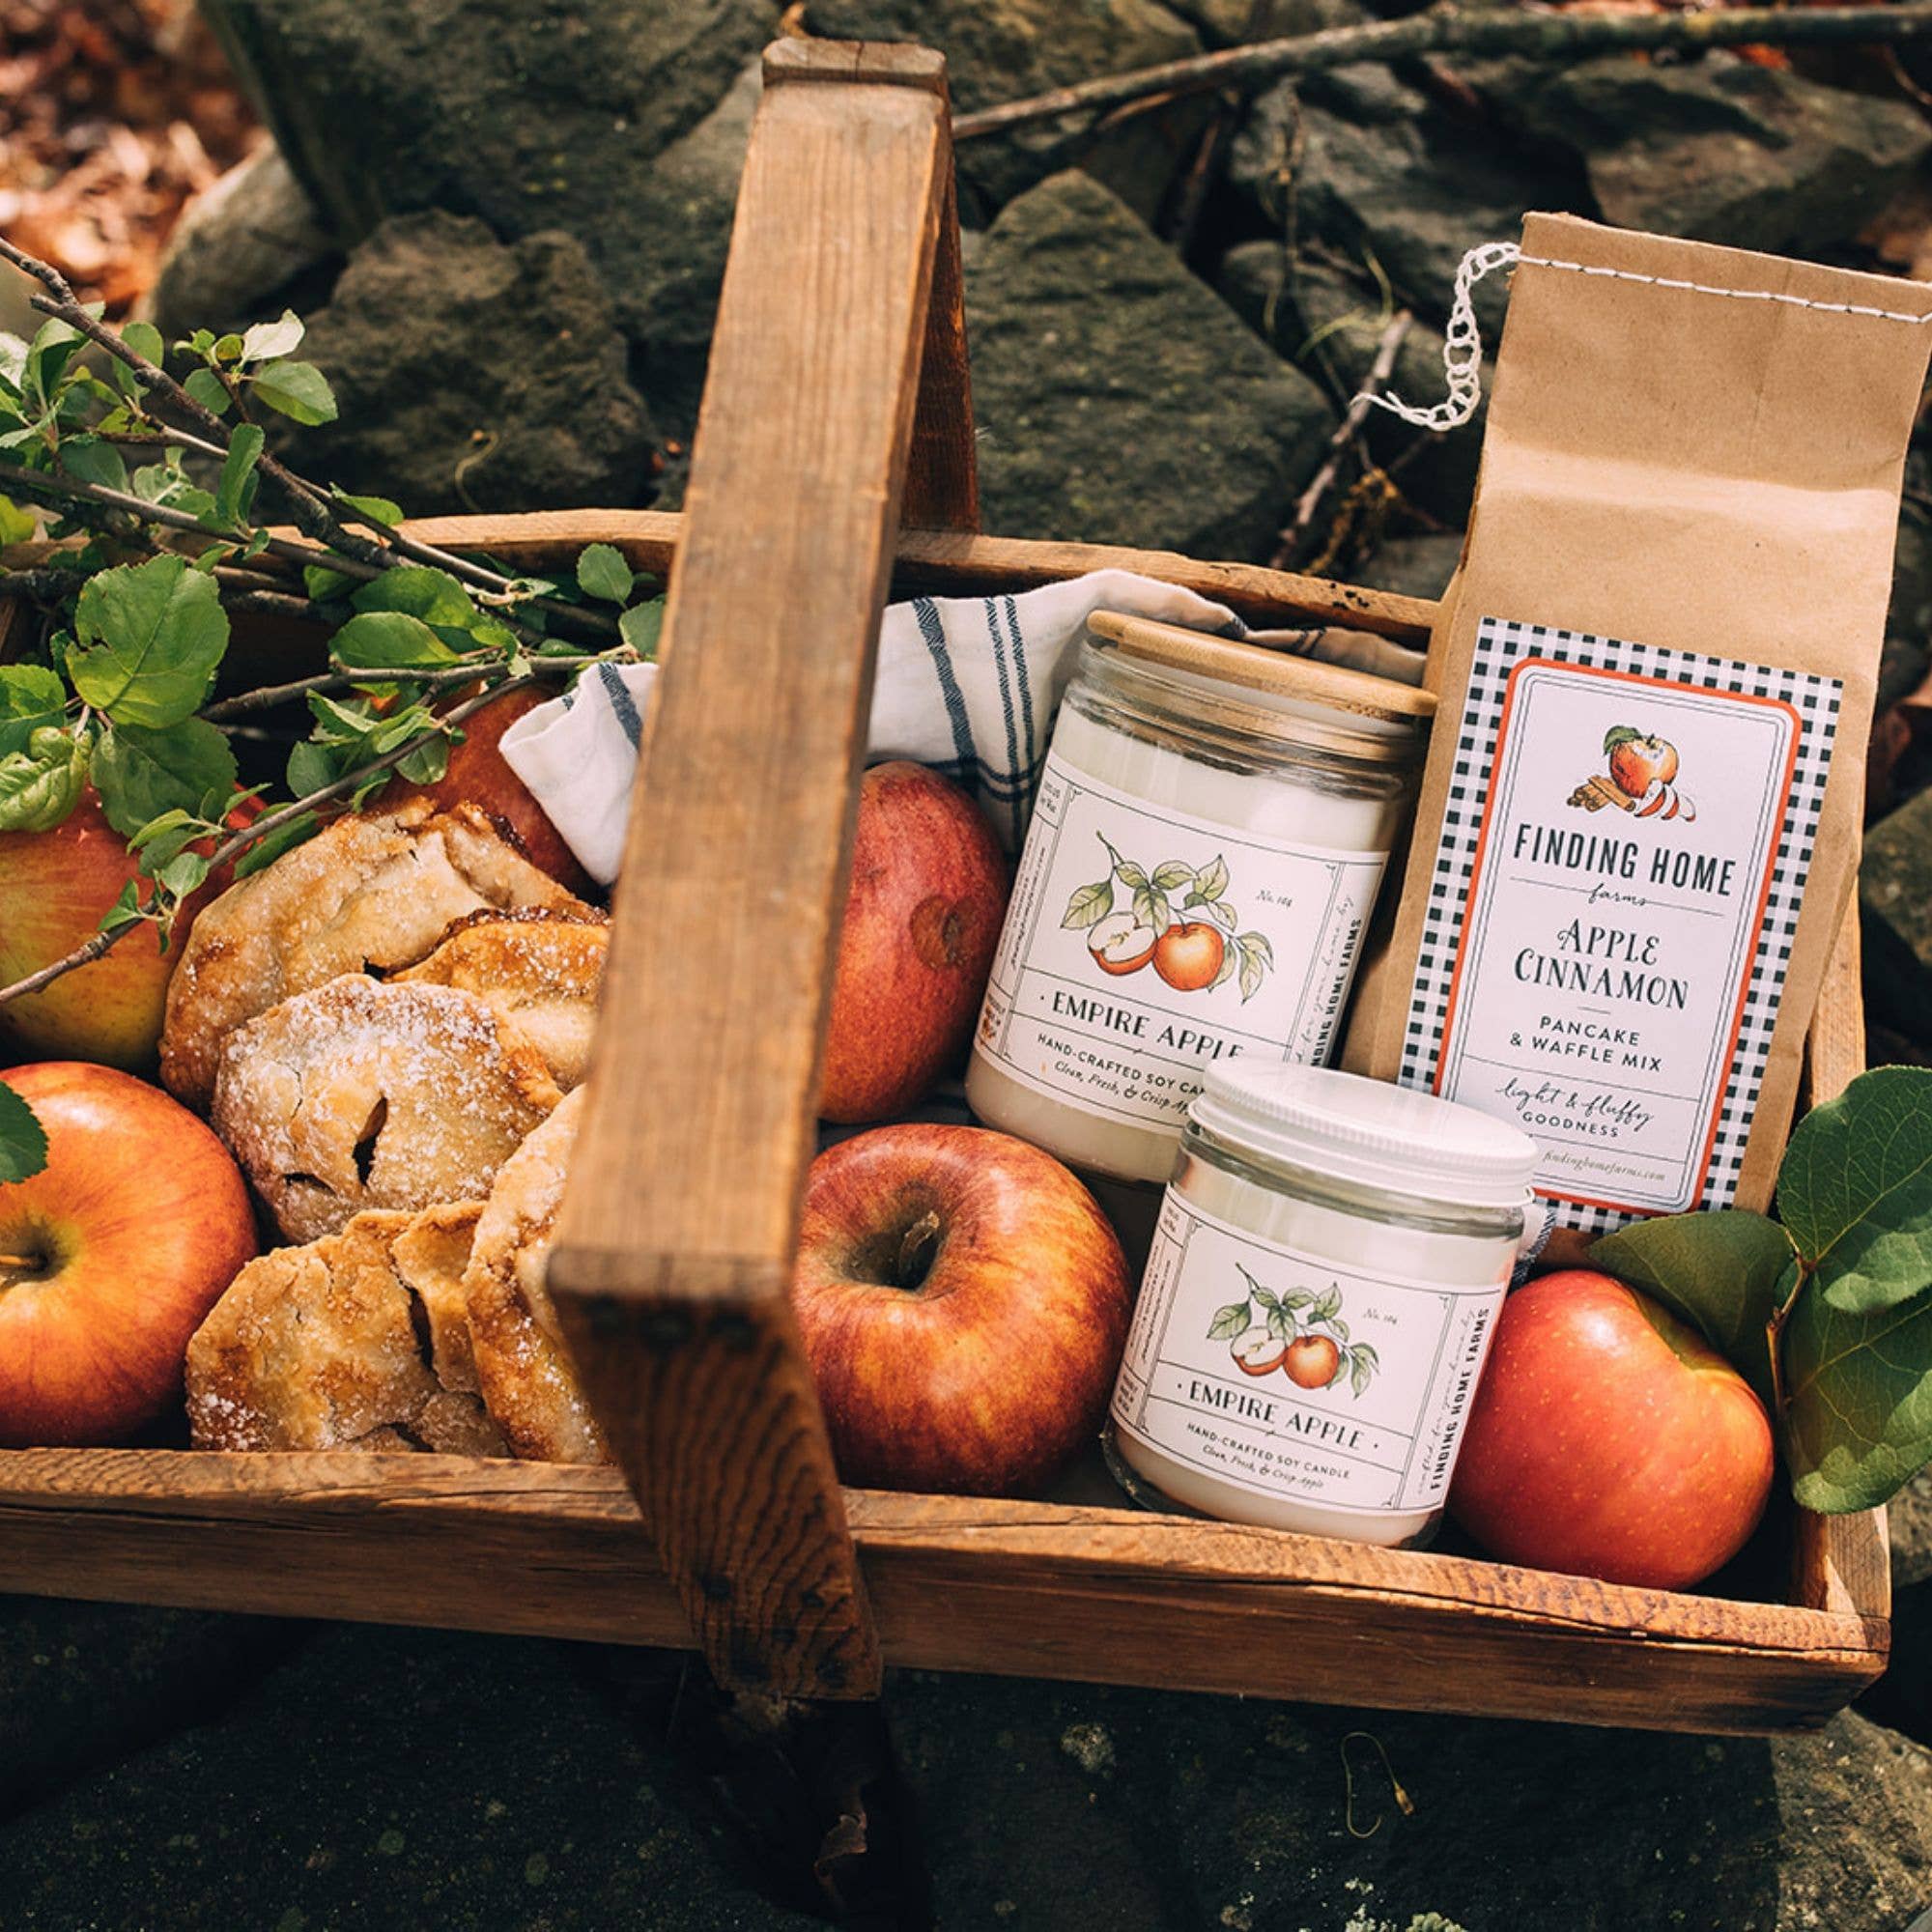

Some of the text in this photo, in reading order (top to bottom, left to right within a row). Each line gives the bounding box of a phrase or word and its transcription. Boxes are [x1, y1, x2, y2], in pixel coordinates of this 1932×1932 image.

[1514, 823, 1736, 896] FINDING HOME
[1587, 882, 1647, 905] farms
[1556, 918, 1661, 966] APPLE
[1310, 919, 1362, 1065] NDING HOME FARMS
[1514, 948, 1690, 1010] CINNAMON
[1052, 990, 1151, 1038] EMPIRE
[1539, 1015, 1640, 1046] PANCAKE
[1037, 1033, 1142, 1080] HAND-CRAFTED
[1146, 1072, 1176, 1090] SOY
[1509, 1032, 1662, 1072] & WAFFLE MIX
[1123, 1084, 1138, 1099] &
[1494, 1076, 1655, 1133] light & fluffy
[1522, 1111, 1619, 1138] GOODNESS
[1189, 1379, 1280, 1425] EMPIRE
[1285, 1411, 1365, 1450] APPLE
[1430, 1307, 1491, 1491] FINDING HOME FARMS
[1186, 1422, 1351, 1480] HAND-CRAFTED SOY CANDLE
